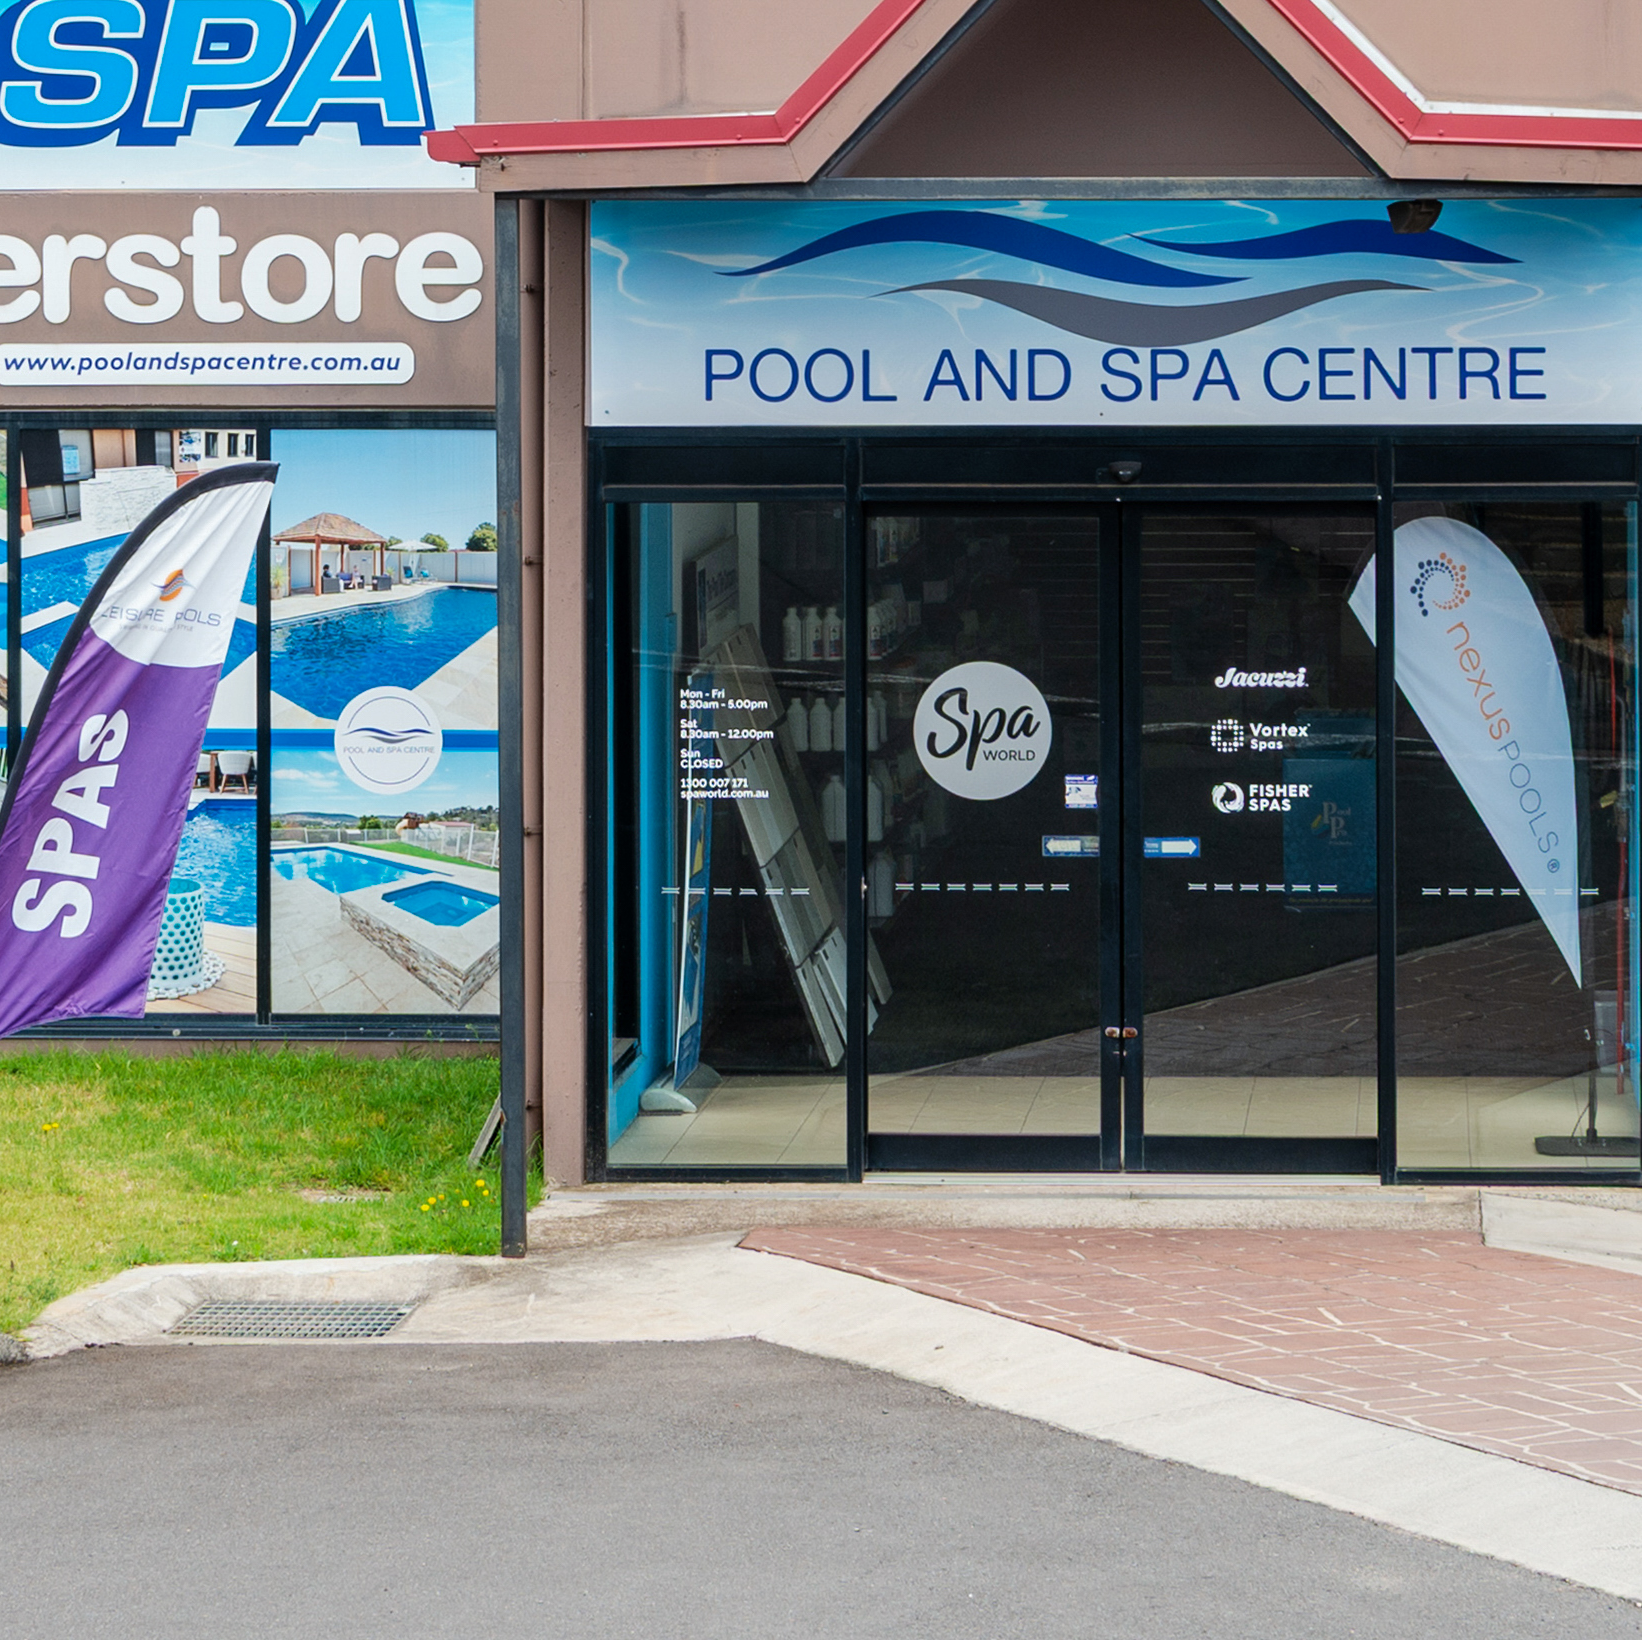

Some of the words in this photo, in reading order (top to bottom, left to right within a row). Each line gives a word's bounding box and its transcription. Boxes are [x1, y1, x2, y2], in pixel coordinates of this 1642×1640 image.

[3, 351, 402, 375] www.poolandspacentre.com.au
[704, 349, 897, 402] POOL
[922, 348, 1072, 401] AND
[1099, 347, 1240, 401] SPA
[1262, 346, 1547, 401] CENTRE
[1214, 667, 1307, 688] Jacuzzi
[680, 689, 703, 699] Mon
[712, 688, 725, 698] Fri
[680, 699, 719, 709] 8.30am
[728, 699, 768, 710] 5.00pm
[680, 719, 697, 728] Sat
[927, 687, 1041, 771] Spa
[680, 730, 719, 739] 8.30am
[728, 729, 774, 740] 12.00pm
[1249, 723, 1309, 737] Vortex
[1250, 739, 1284, 751] Spas
[680, 749, 701, 758] Sun
[982, 750, 1036, 761] WORLD
[680, 759, 723, 768] CLOSED
[680, 779, 707, 788] 1300
[709, 778, 730, 788] 007
[731, 778, 748, 788] 171
[680, 789, 769, 800] spaworld.com.au
[1249, 784, 1310, 797] FISHER
[1249, 798, 1291, 811] SPAS
[12, 709, 129, 938] SPAS
